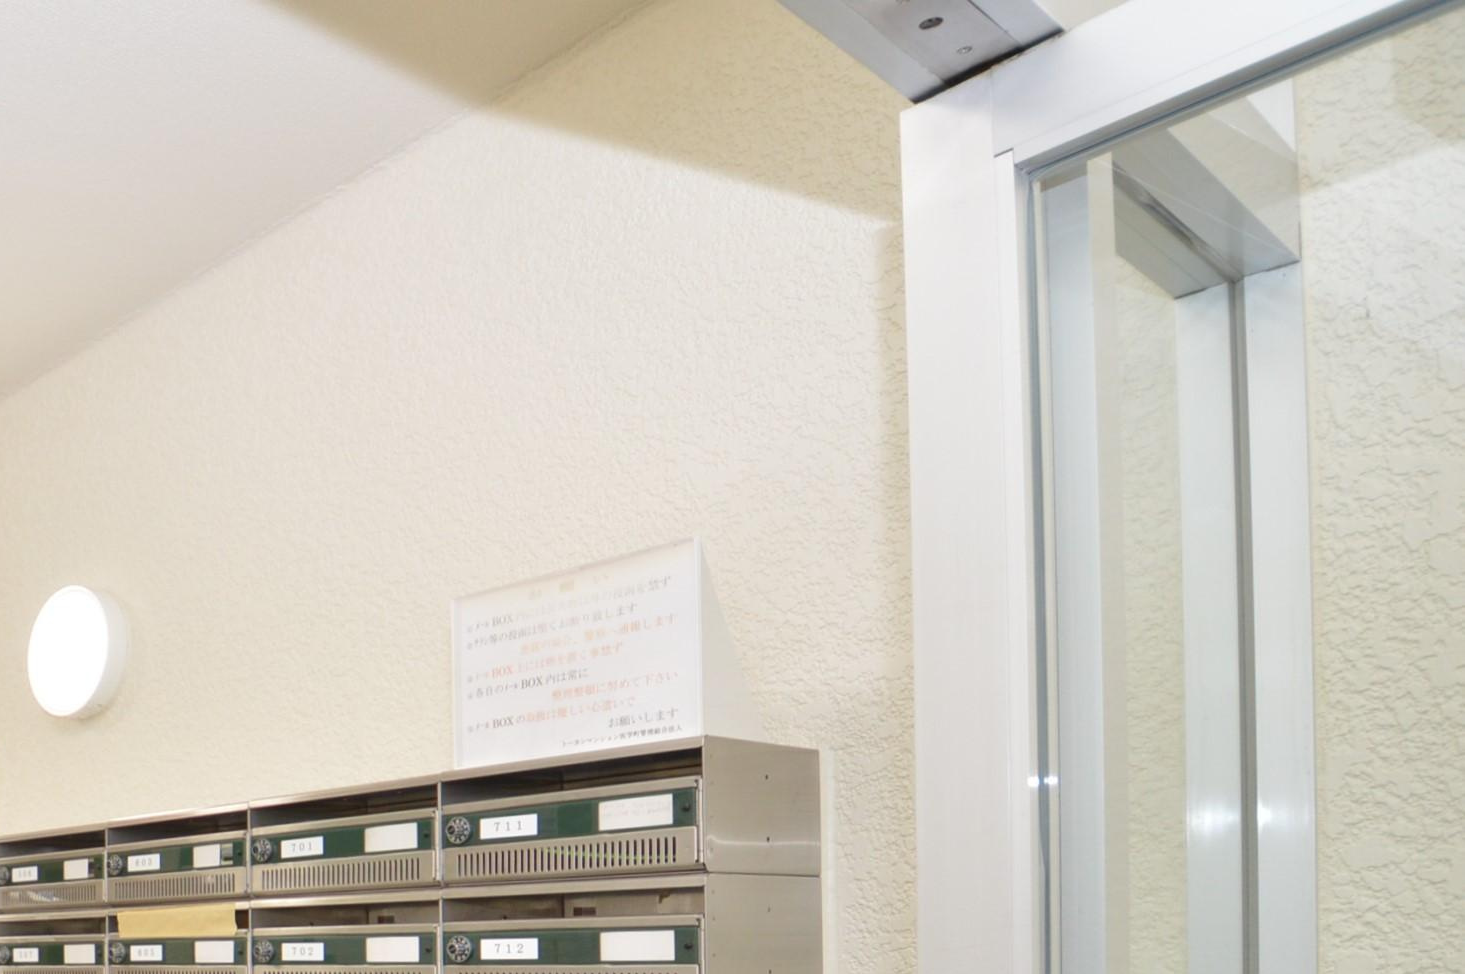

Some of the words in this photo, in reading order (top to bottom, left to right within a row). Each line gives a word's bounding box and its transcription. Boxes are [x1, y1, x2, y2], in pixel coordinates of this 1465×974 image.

[494, 820, 523, 832] 711
[291, 841, 313, 852] 701
[291, 947, 315, 956] 702
[494, 943, 524, 954] 712
